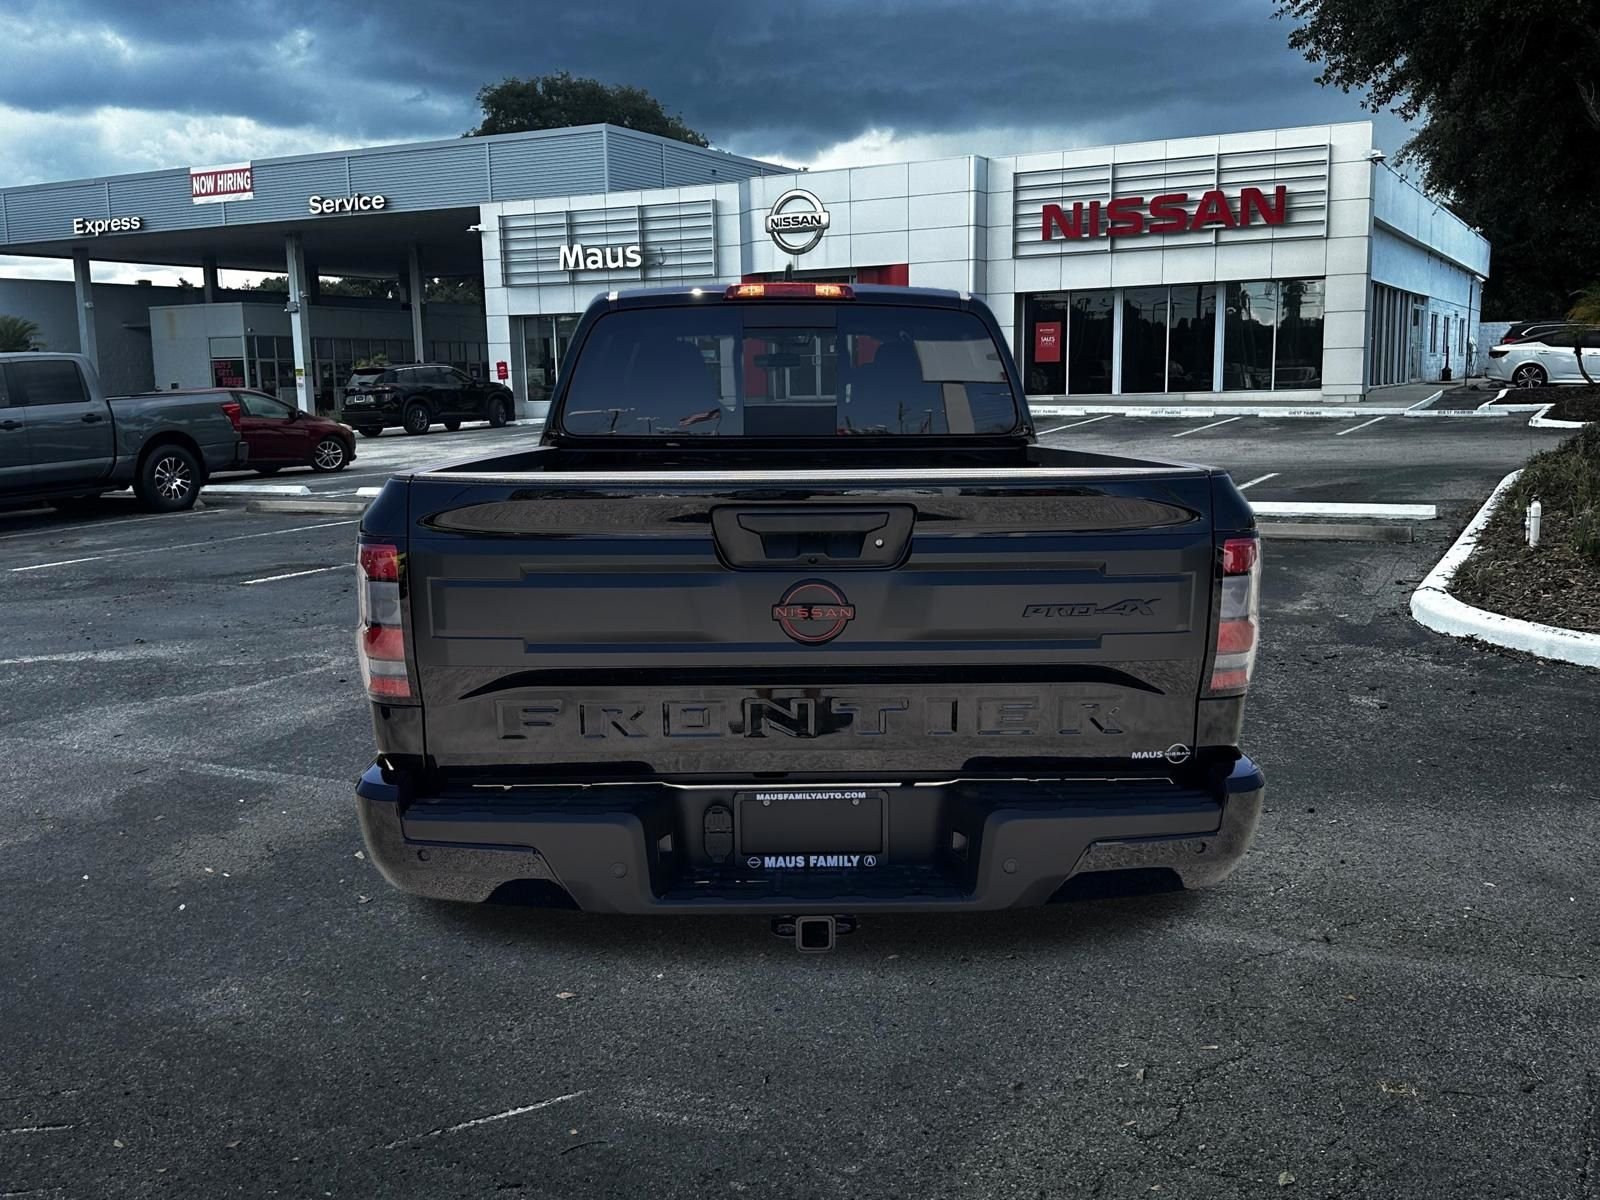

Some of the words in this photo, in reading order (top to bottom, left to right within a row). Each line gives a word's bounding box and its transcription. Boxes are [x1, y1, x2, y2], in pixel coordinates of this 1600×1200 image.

[192, 174, 215, 195] NOW
[217, 171, 251, 192] HIRING
[308, 193, 385, 214] Service
[1041, 185, 1287, 241] NISSAN
[73, 215, 141, 236] Express
[770, 213, 823, 230] NISSAN
[559, 243, 642, 272] Maus
[775, 607, 853, 618] NISSAN
[1022, 598, 1162, 618] PRO-4X
[496, 696, 1125, 739] FRONTIER
[1131, 751, 1164, 759] MAUS
[756, 791, 866, 801] MAUSFAMILYAUTO.COM
[764, 855, 805, 868] MAUS
[809, 855, 860, 867] FAMILY
